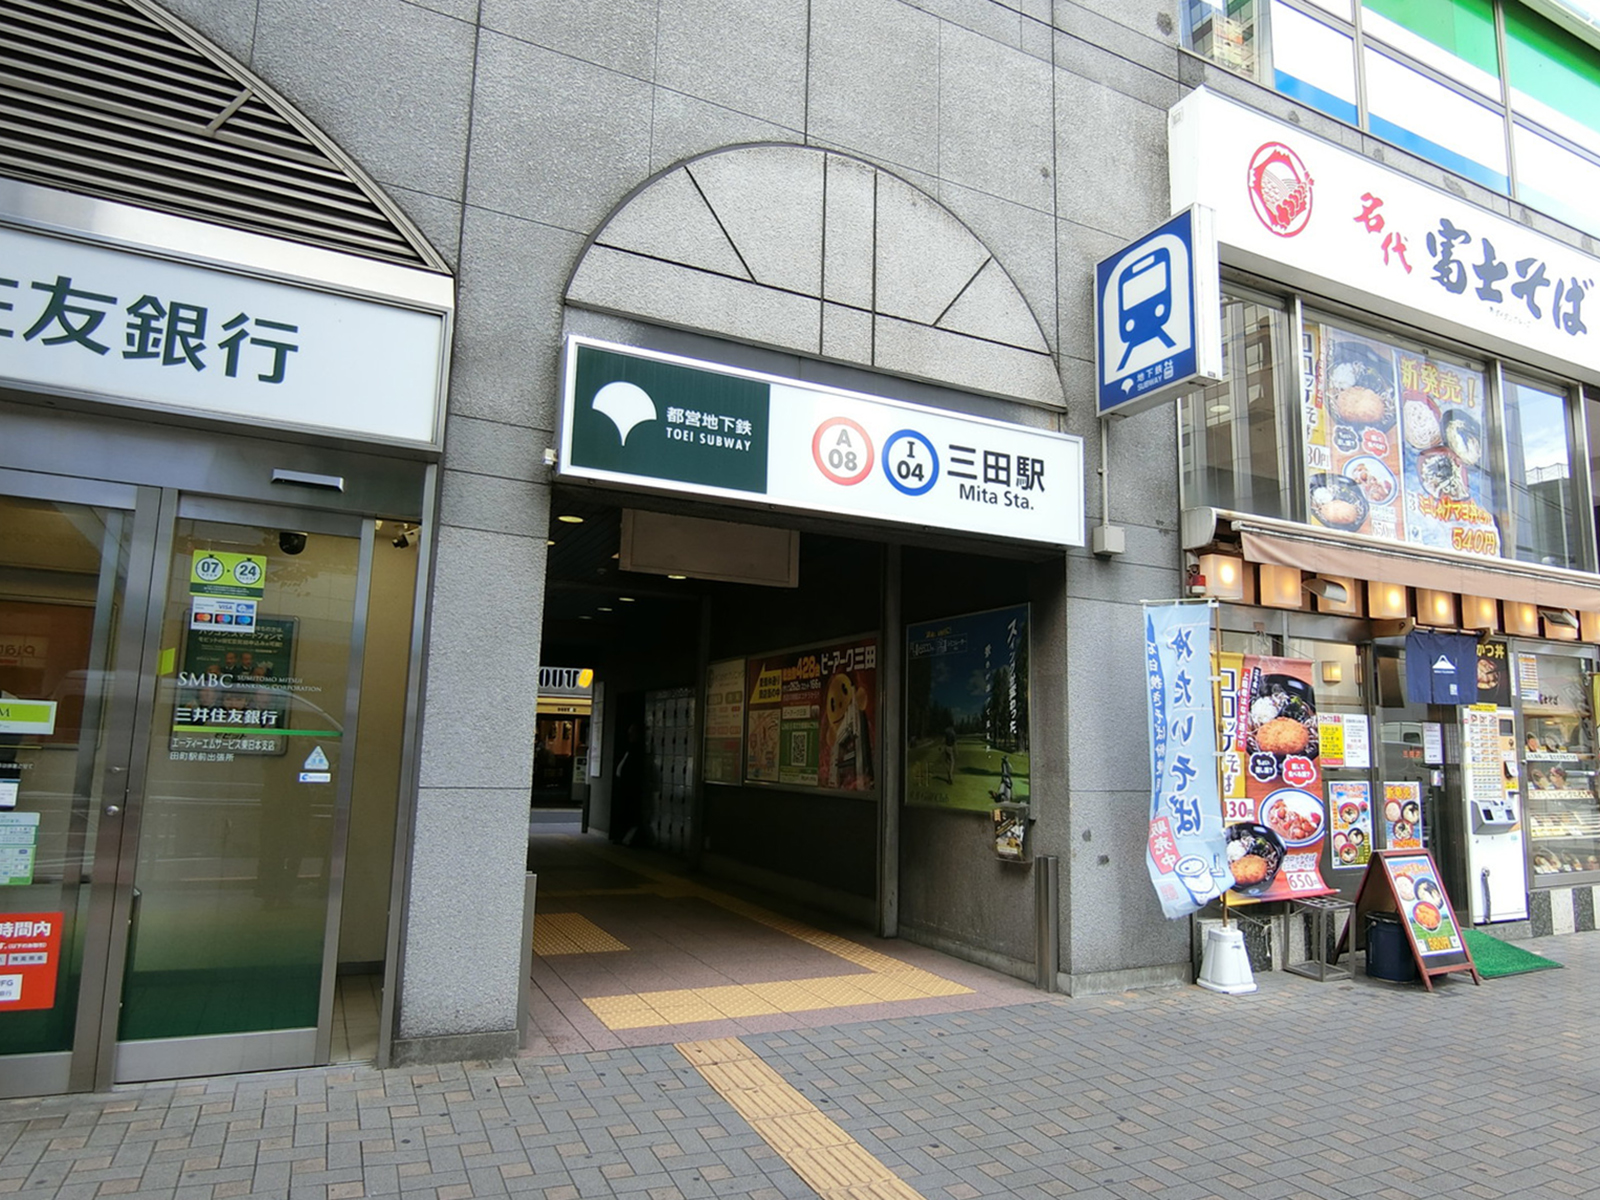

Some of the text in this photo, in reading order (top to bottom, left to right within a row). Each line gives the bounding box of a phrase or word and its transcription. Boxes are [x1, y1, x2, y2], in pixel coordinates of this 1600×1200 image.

[1353, 192, 1412, 274] 名代
[1426, 218, 1594, 337] 富士そば
[0, 275, 299, 385] 友銀行
[1137, 364, 1163, 383] 地下鉄
[1137, 374, 1163, 393] SUBWAY
[667, 405, 753, 437] 都営地下鉄
[666, 427, 752, 452] TOEI SUBWAY
[836, 429, 853, 448] A
[906, 442, 916, 458] I
[828, 449, 859, 473] 08
[947, 443, 1046, 494] 三田駅
[897, 459, 925, 484] 04
[959, 482, 1035, 511] Mita Sta.
[1452, 526, 1497, 555] 540円
[201, 561, 219, 574] 07
[240, 564, 257, 577] 24
[821, 644, 877, 675] ビーアーク三田
[1476, 643, 1506, 659] かつ丼
[177, 671, 303, 689] SMBC SUMITOMO MITSUI
[237, 682, 322, 693] BANKING CORPORATION
[175, 707, 278, 725] 三井住友銀行
[170, 751, 236, 763] 田町駅前出張所
[0, 921, 52, 938] 時間内
